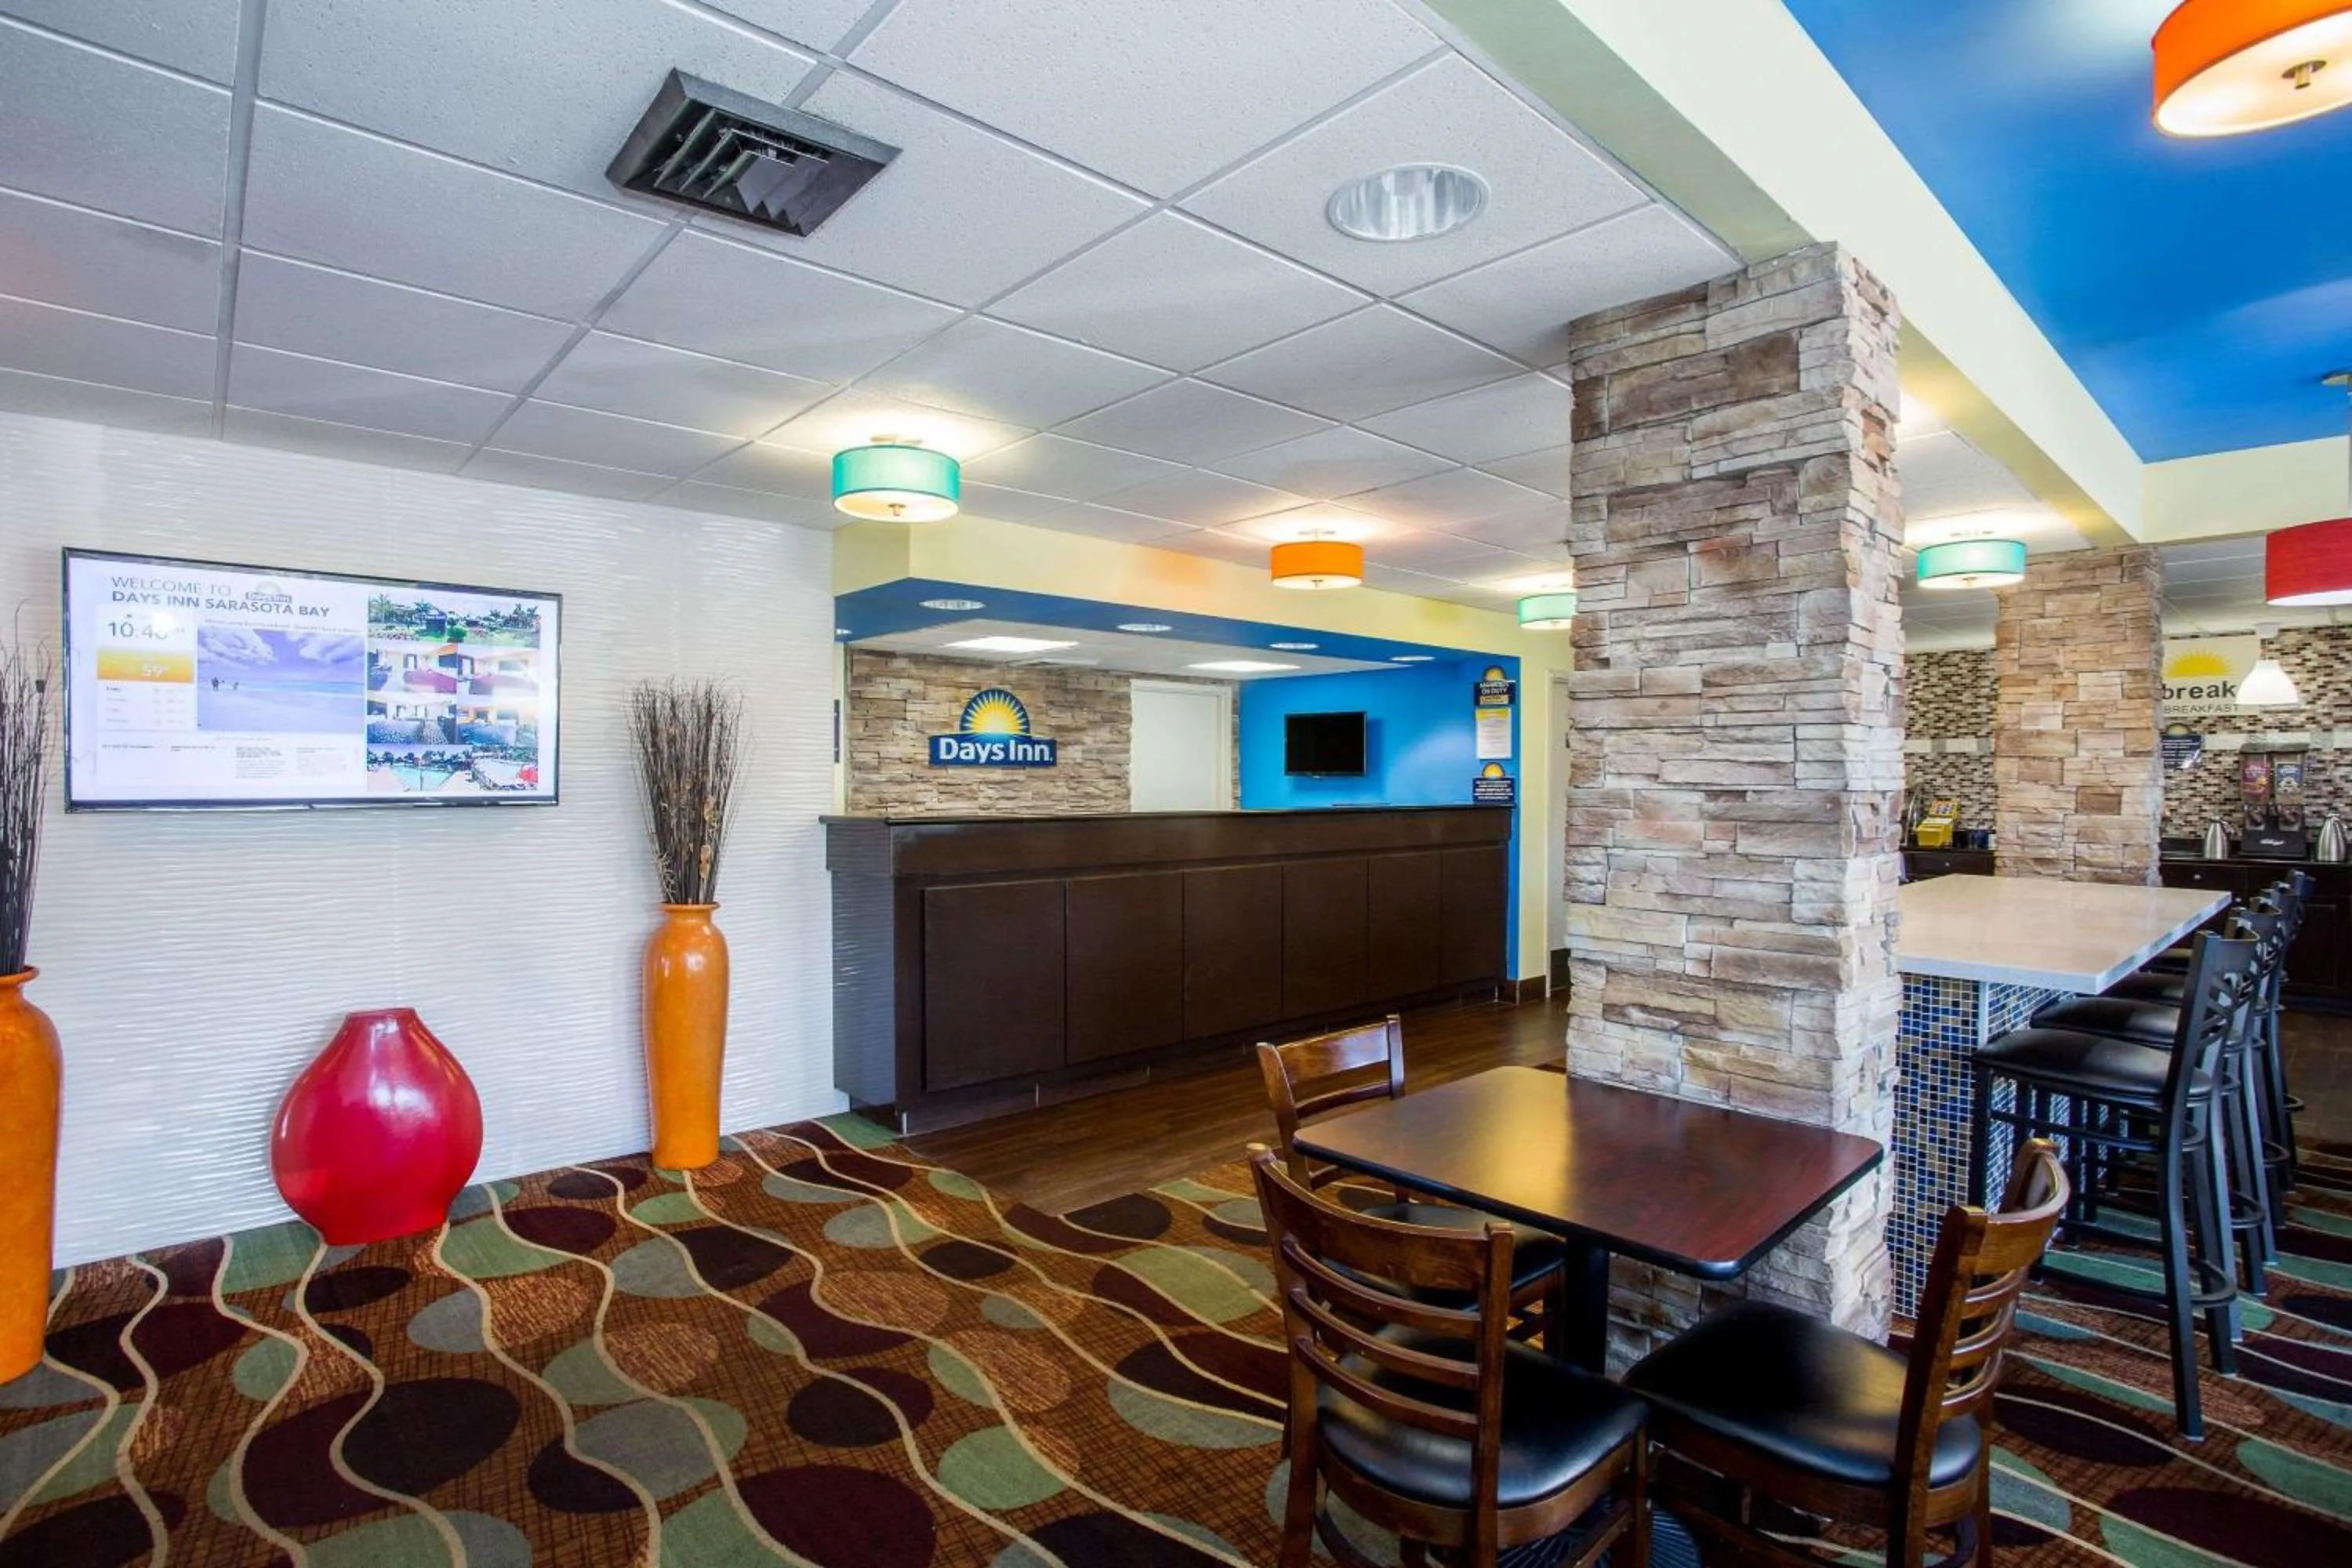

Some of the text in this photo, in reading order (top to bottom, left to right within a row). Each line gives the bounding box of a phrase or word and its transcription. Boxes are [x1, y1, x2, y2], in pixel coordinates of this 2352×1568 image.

[111, 576, 201, 595] WELCOME
[210, 583, 231, 597] TO
[112, 590, 330, 618] DAYS INN SARASOTA BAY
[2164, 704, 2239, 714] BREAKFAST
[939, 737, 1050, 764] Days Inn
